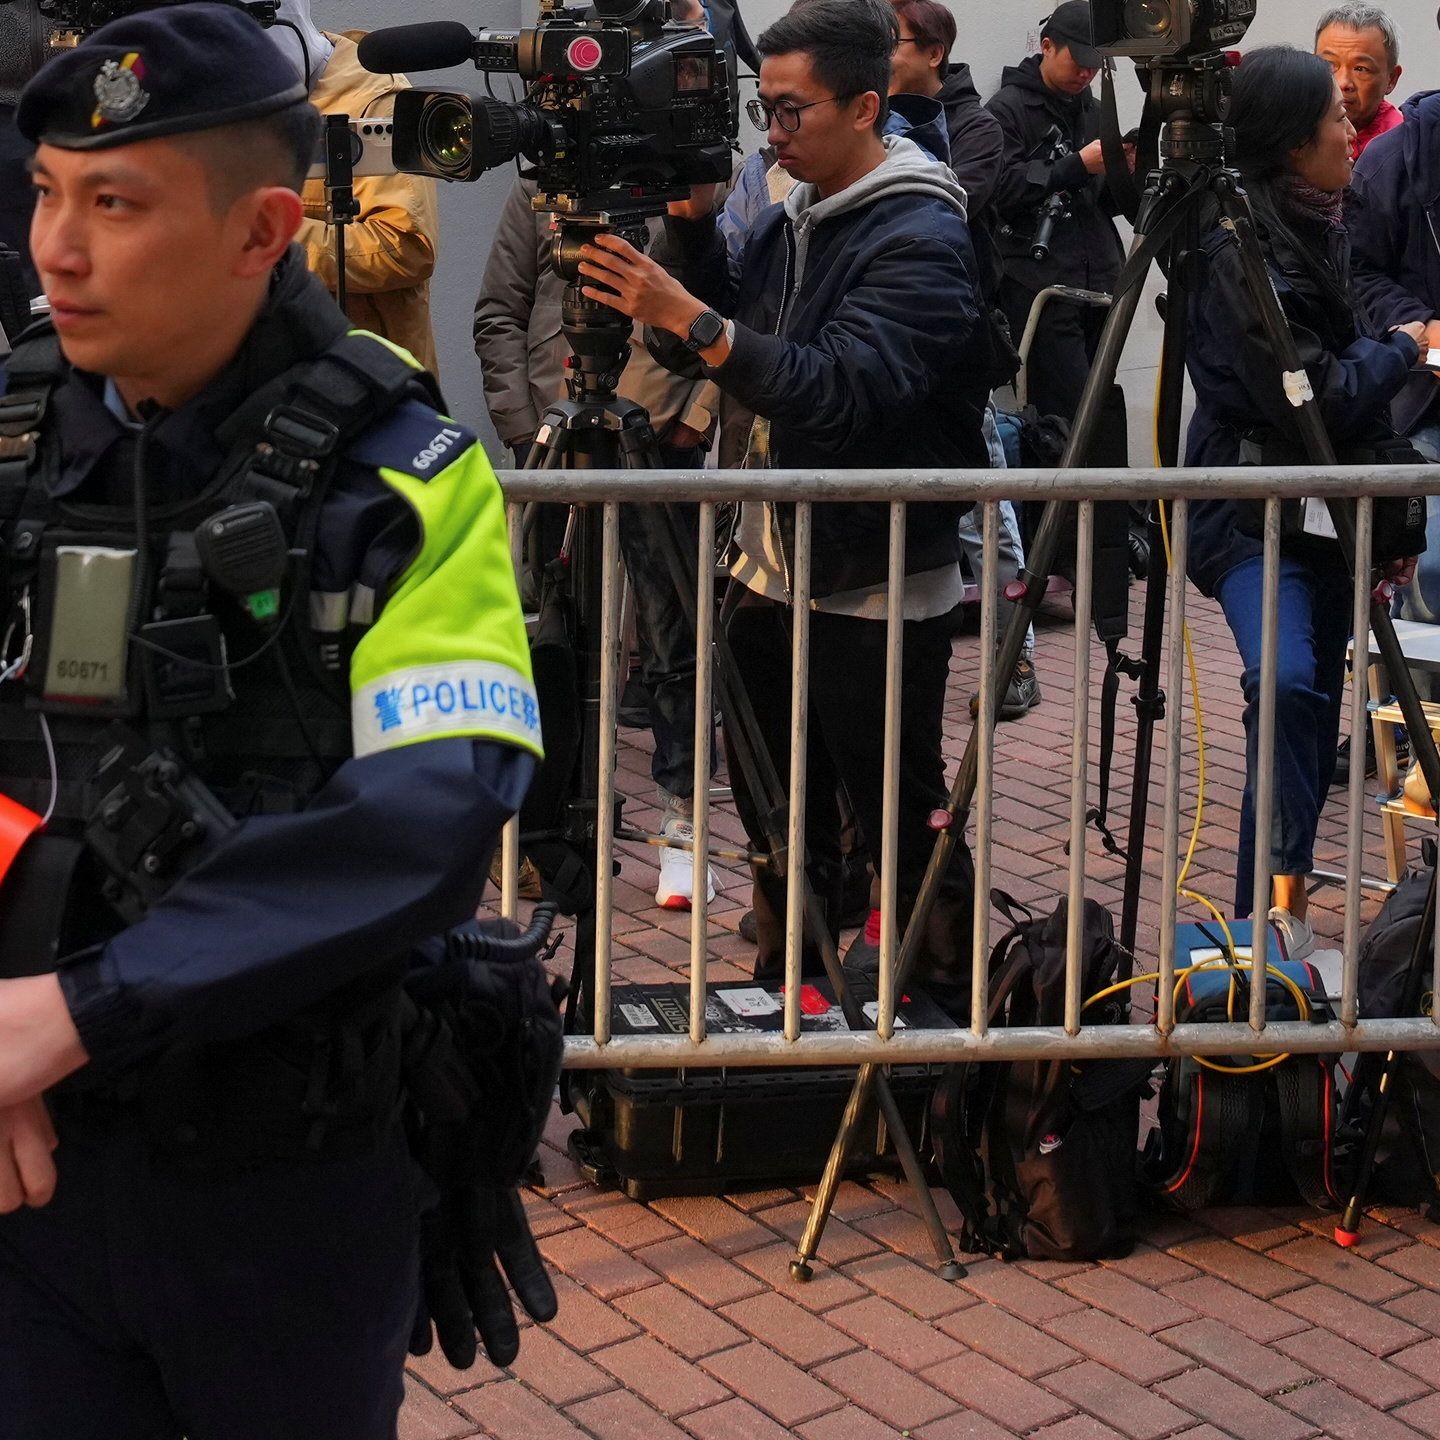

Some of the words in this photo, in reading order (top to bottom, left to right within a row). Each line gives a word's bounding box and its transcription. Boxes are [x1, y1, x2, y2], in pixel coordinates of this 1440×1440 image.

[412, 427, 462, 471] 60671
[56, 661, 109, 682] 60671
[373, 686, 404, 732] 警
[412, 677, 525, 719] POLICE
